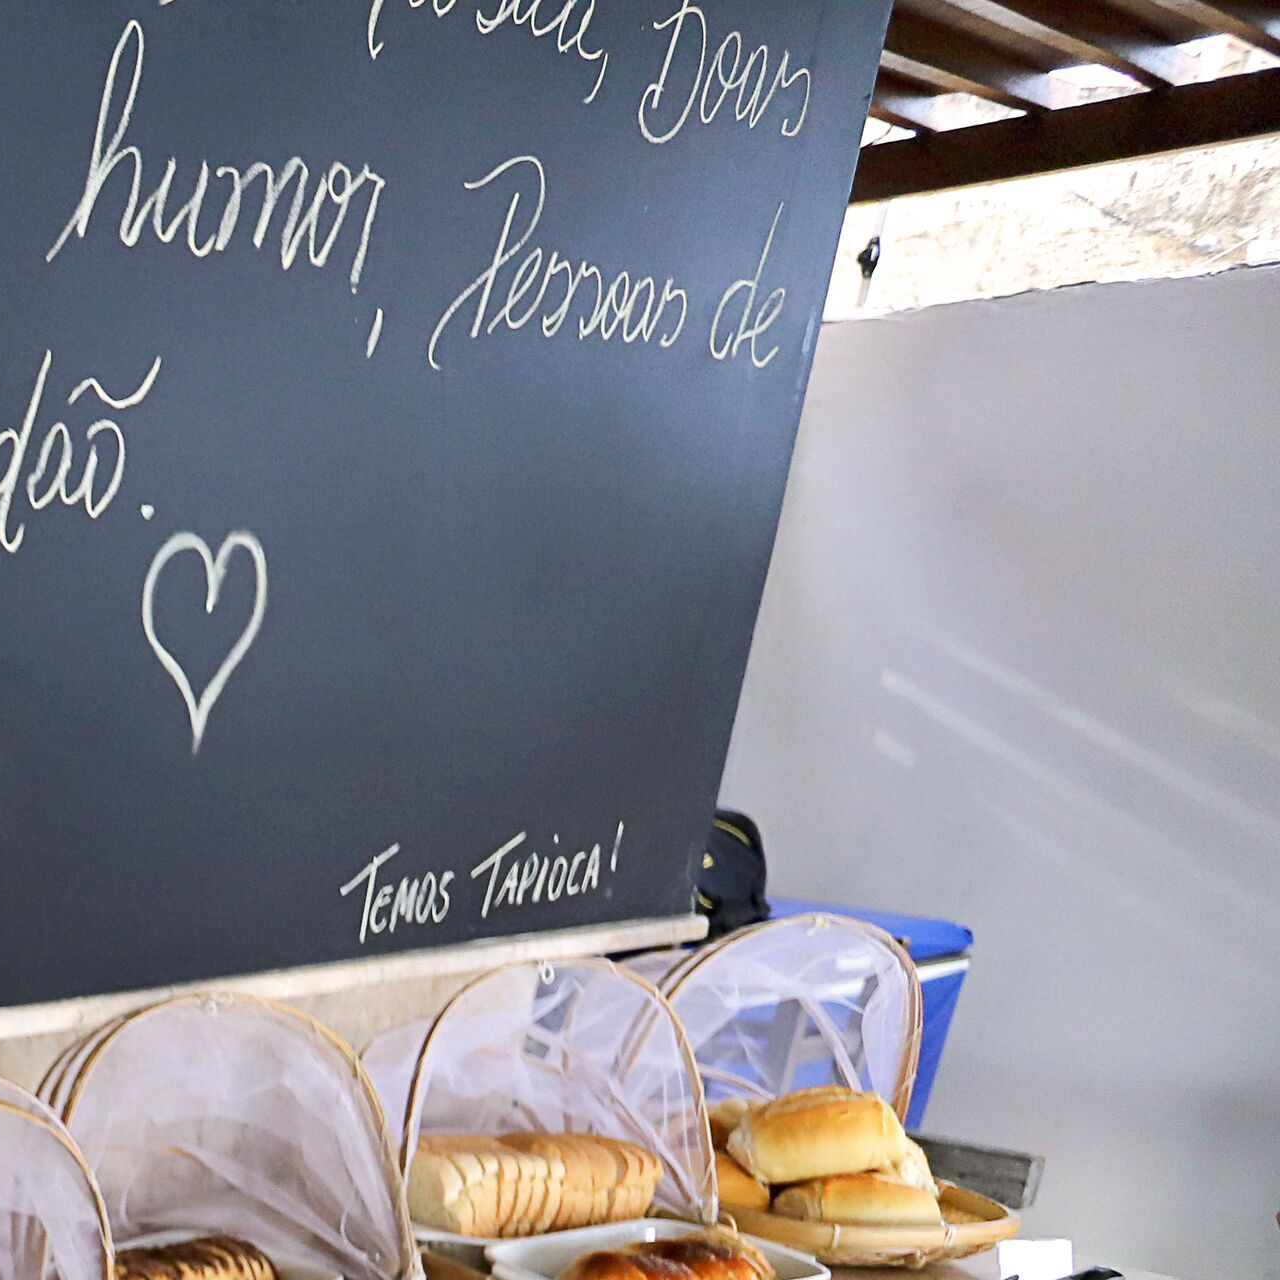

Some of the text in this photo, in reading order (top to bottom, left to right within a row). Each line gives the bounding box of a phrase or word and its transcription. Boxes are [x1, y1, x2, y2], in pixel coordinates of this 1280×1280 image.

[47, 19, 386, 358] humor,
[428, 155, 688, 371] Pessoas
[709, 202, 786, 369] de
